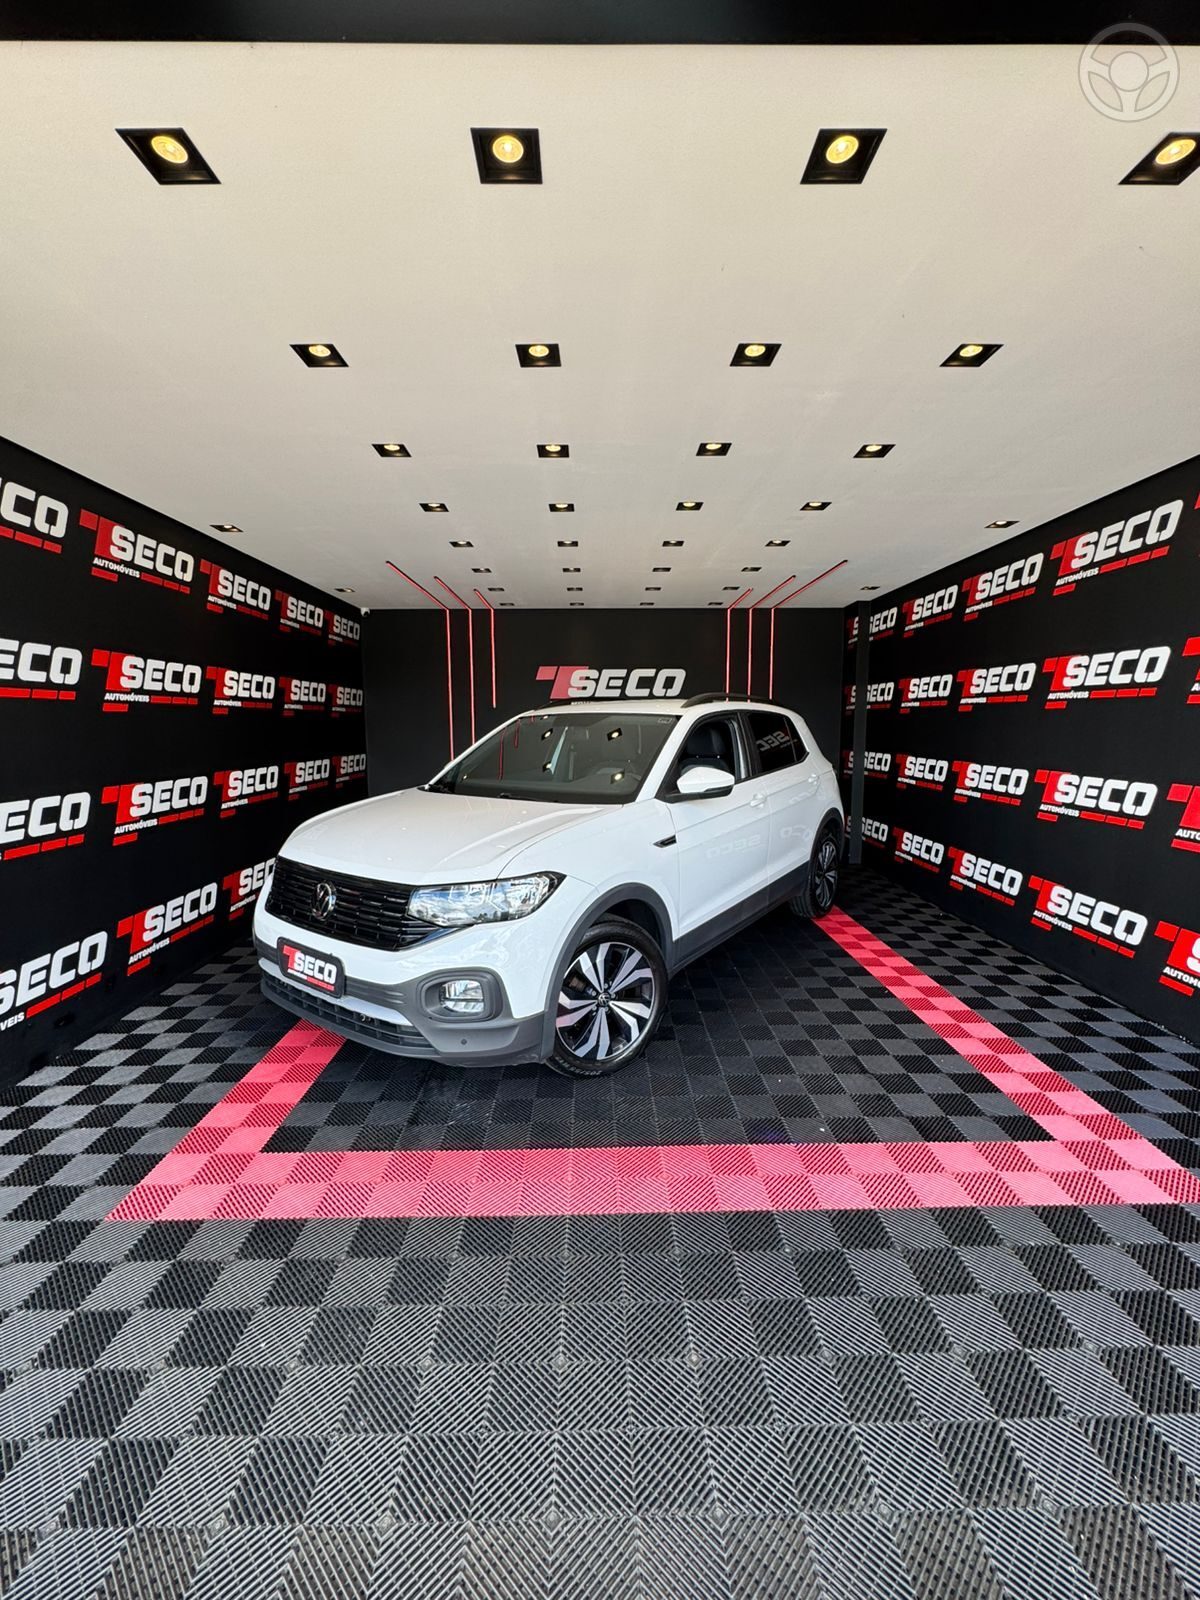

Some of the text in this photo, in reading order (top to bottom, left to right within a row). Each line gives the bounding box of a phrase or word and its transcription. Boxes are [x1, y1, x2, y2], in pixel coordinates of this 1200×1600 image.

[0, 477, 69, 538] CO
[93, 557, 140, 578] AUTOMÓVEIS
[1056, 567, 1099, 586] AUTOMÓVEIS
[104, 692, 150, 704] AUTOMÓVEIS
[1047, 690, 1089, 699] AUTOMÓVEIS
[1039, 803, 1080, 817] AUTOMÓVEIS
[115, 818, 158, 834] AUTOMÓVEIS
[1033, 909, 1074, 931] AUTOMÓVEIS
[128, 938, 170, 965] AUTOMÓVEIS
